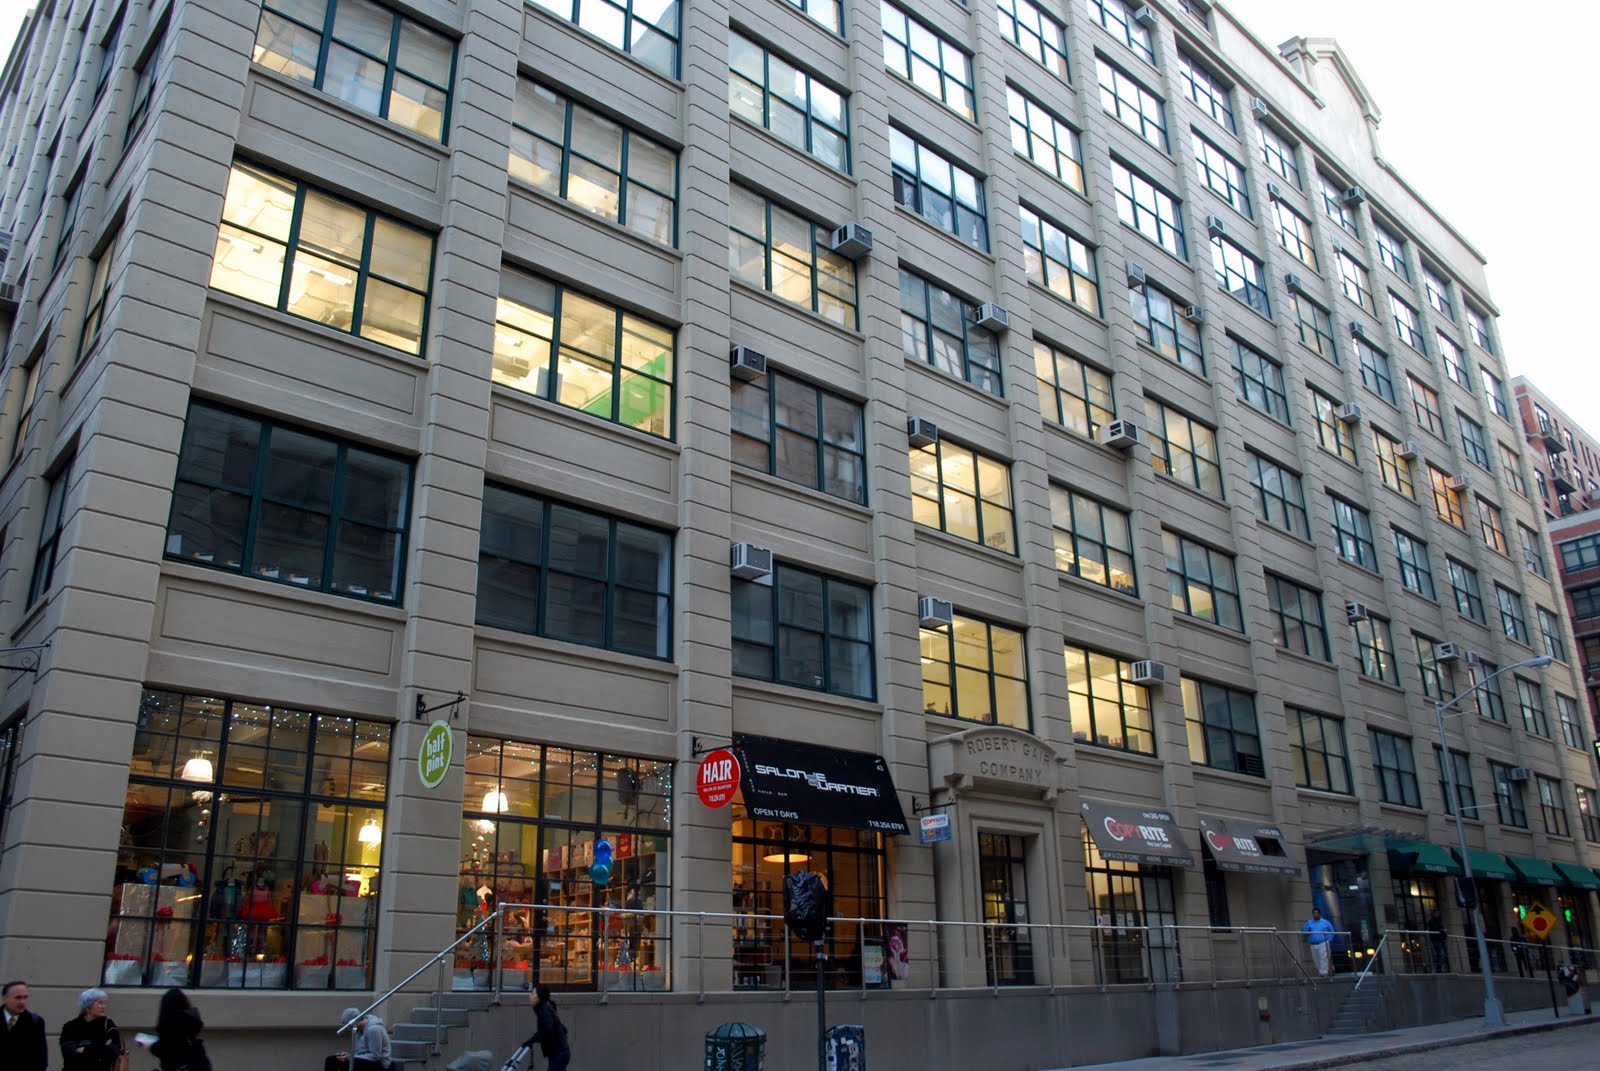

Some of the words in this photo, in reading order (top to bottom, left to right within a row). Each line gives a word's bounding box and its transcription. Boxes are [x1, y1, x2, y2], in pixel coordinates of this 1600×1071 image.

[427, 732, 445, 757] half
[967, 737, 1017, 755] ROBERT
[1023, 743, 1050, 767] GAIR
[426, 752, 444, 777] pint
[703, 759, 732, 784] HAIR
[755, 764, 807, 780] SALON
[980, 761, 1041, 782] COMPANY
[753, 807, 774, 817] OPEN
[774, 809, 779, 817] 7
[780, 810, 799, 819] DAYS
[1104, 816, 1168, 842] COPYRITE
